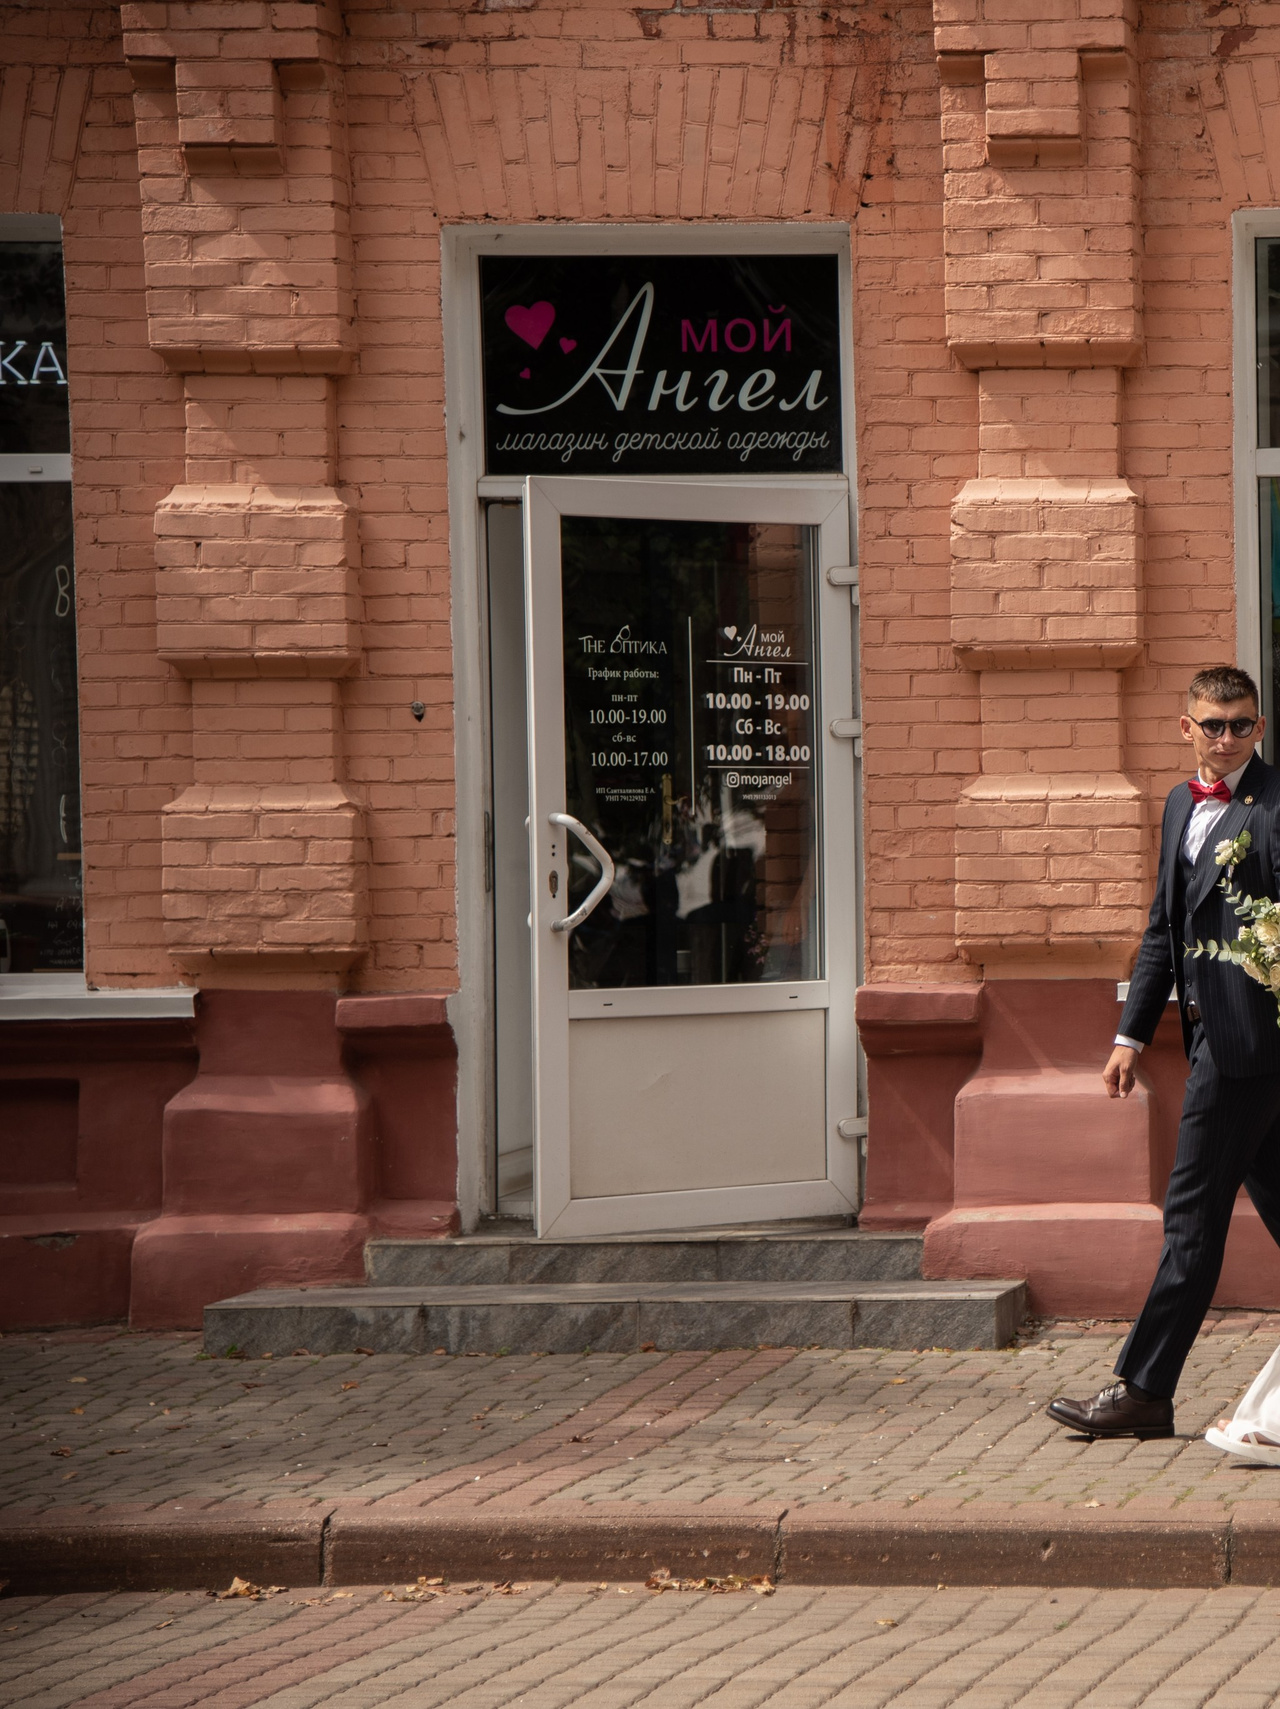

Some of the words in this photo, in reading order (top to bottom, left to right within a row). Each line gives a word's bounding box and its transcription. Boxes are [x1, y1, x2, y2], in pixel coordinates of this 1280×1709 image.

[496, 281, 829, 415] Ангел
[496, 432, 608, 463] магазин
[612, 427, 722, 463] детской
[727, 431, 830, 462] одежды
[723, 623, 792, 657] Ангел
[588, 667, 621, 680] График
[623, 668, 660, 681] работы:
[733, 667, 753, 683] Пн
[764, 668, 782, 684] Пт
[611, 694, 638, 702] пн-пт
[706, 692, 752, 709] 10.00
[765, 693, 810, 711] 19.00
[589, 709, 667, 724] 10.00-19.00
[735, 718, 754, 735] Сб
[764, 719, 781, 735] Вс
[612, 732, 637, 742] сб-вс
[591, 751, 669, 767] 10.00-17.00
[706, 744, 752, 761] 10.00
[765, 745, 810, 762] 18.00
[740, 772, 792, 788] mojangel
